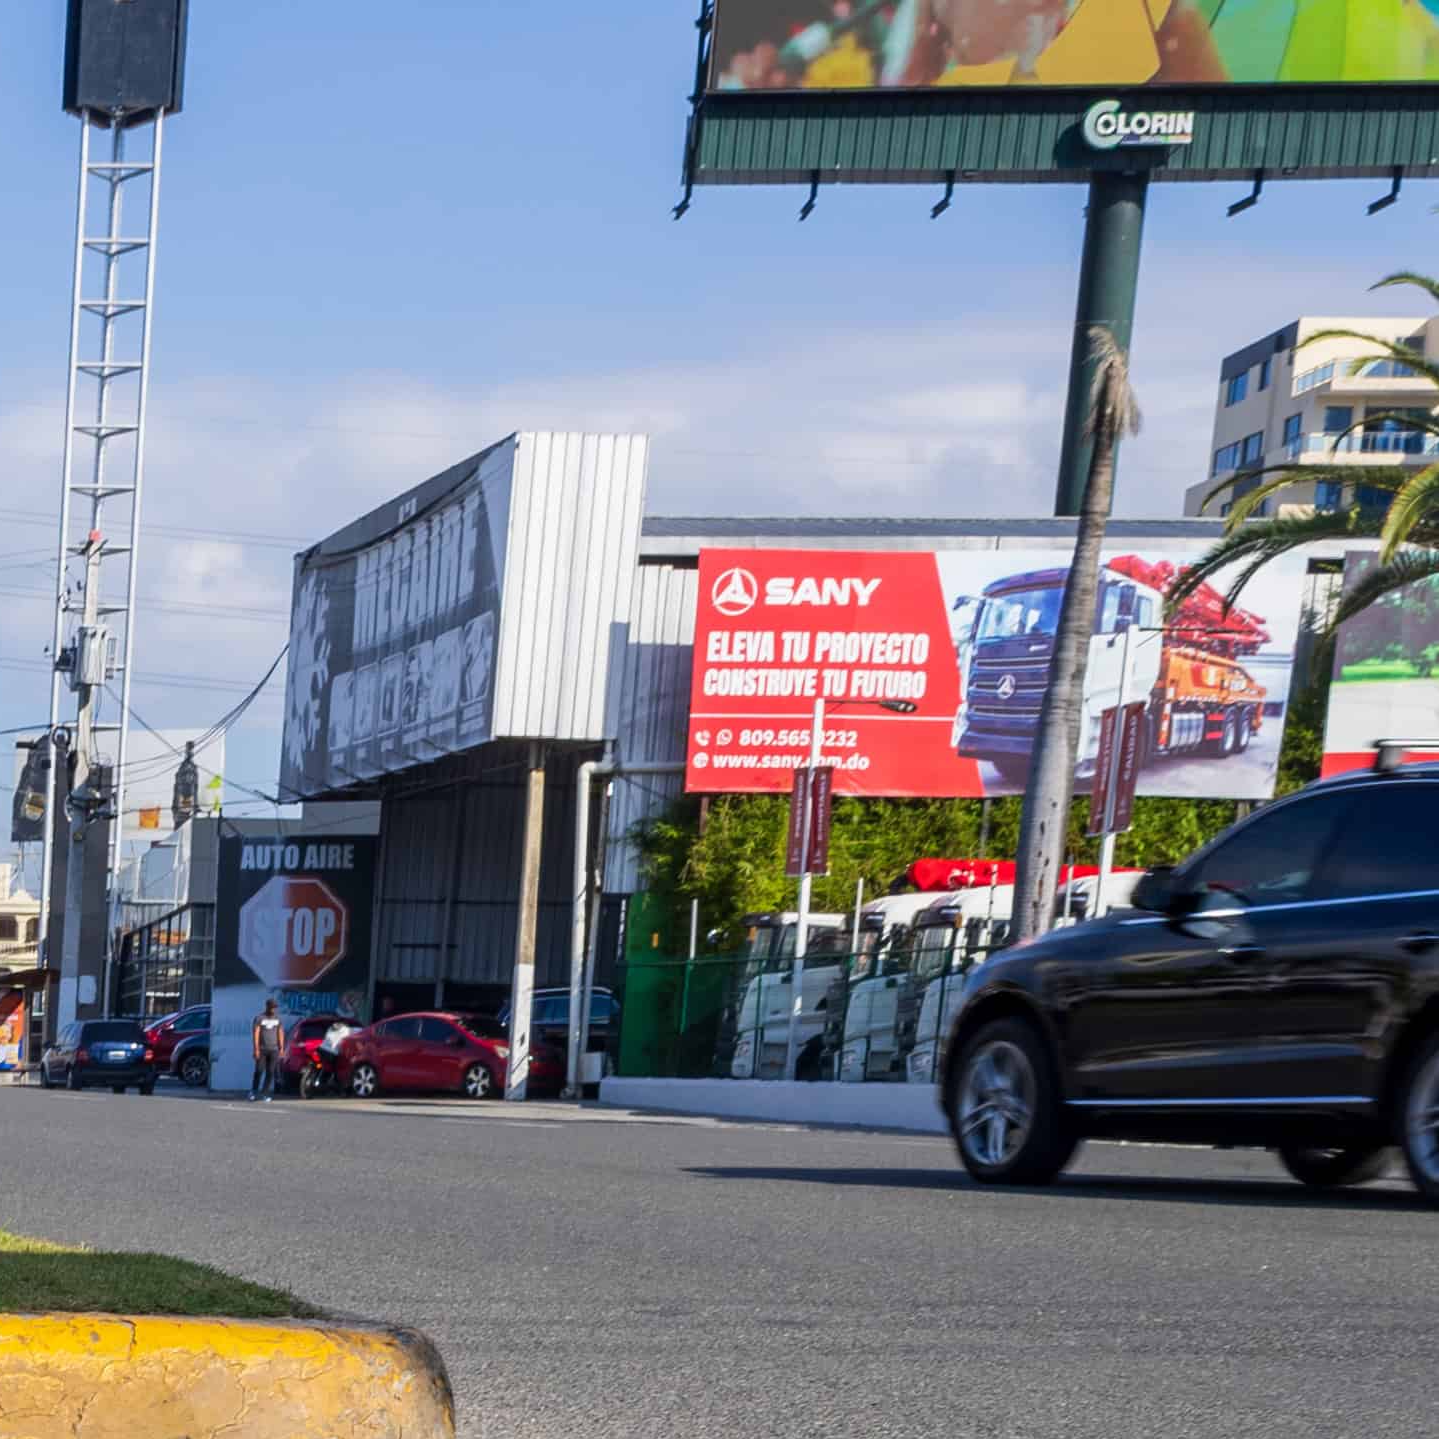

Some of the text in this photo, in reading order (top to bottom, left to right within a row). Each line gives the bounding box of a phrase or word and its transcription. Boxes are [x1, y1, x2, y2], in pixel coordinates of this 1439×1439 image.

[1084, 99, 1194, 149] COLORIN
[764, 577, 882, 606] SANY
[706, 630, 930, 665] ELEVA TU PROYECTO
[703, 668, 927, 699] CONSTRUYE TU FUTURO
[712, 752, 870, 770] www.sany.om.do
[240, 844, 355, 870] AUTO AIRE
[253, 906, 336, 957] STOP
